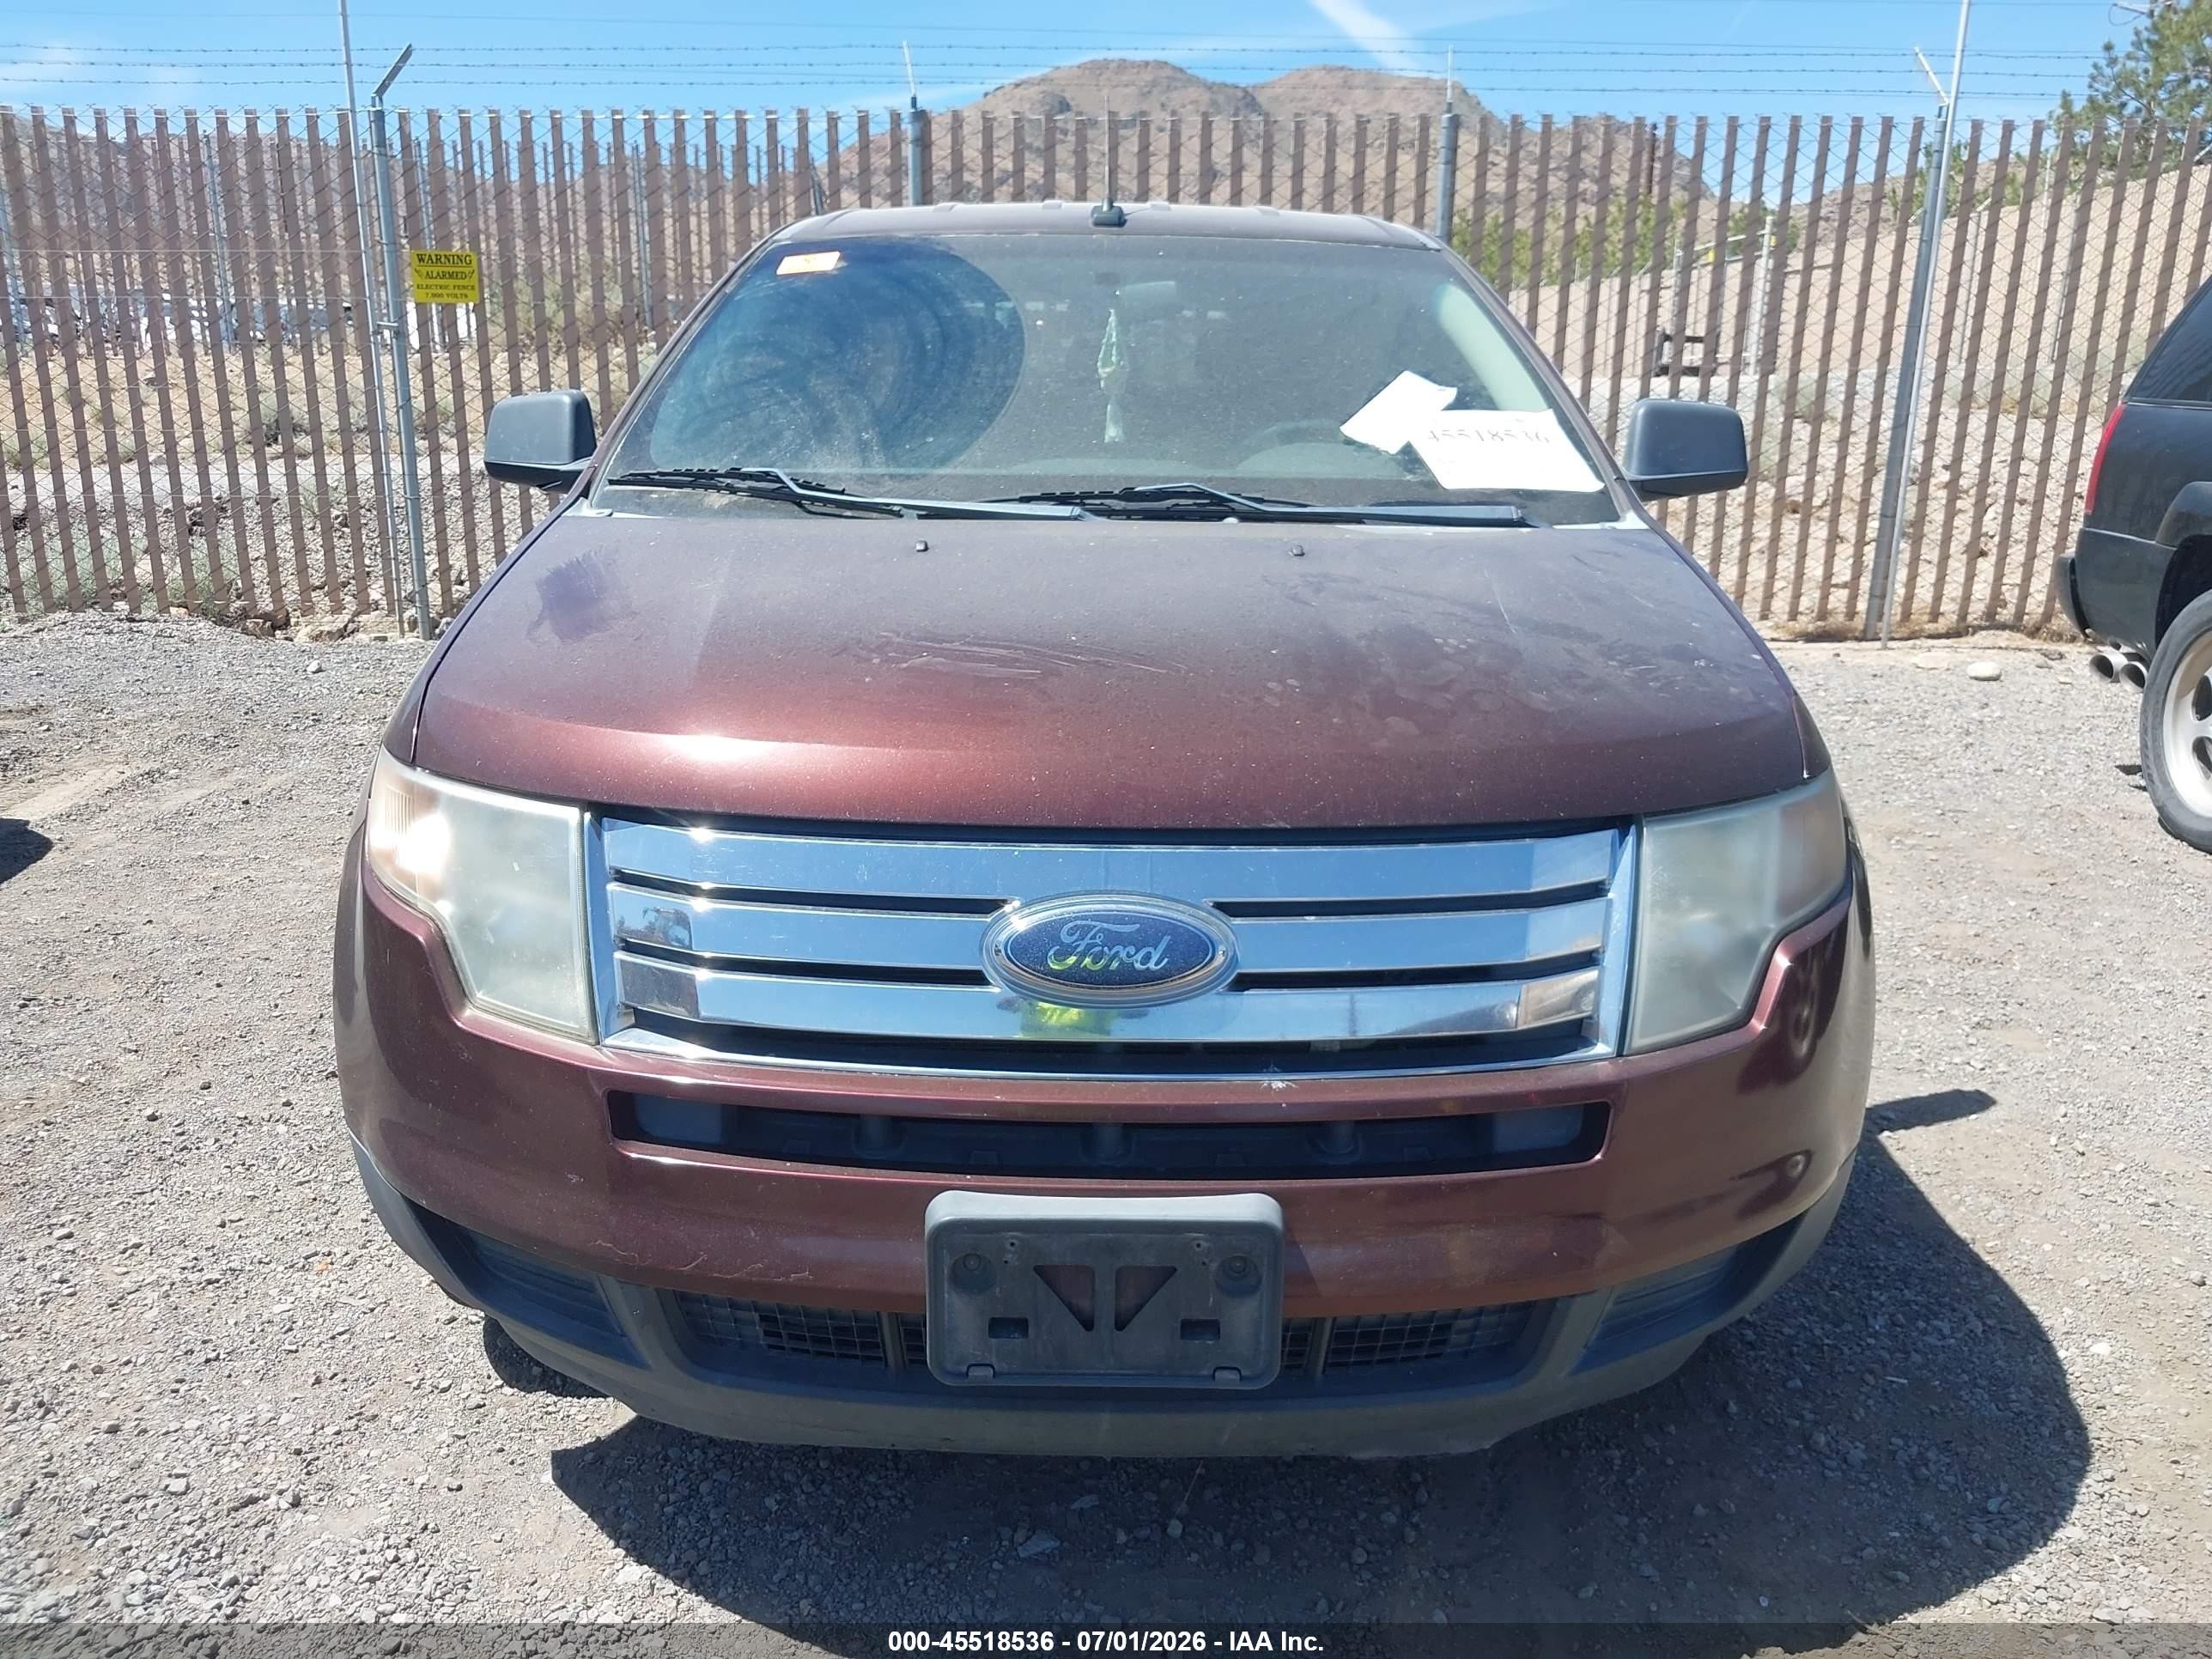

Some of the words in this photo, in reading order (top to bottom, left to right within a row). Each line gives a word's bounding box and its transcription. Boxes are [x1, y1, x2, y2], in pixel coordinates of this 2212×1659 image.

[416, 253, 472, 265] WARNING
[425, 270, 467, 280] ALARMED
[1047, 920, 1171, 971] Ford
